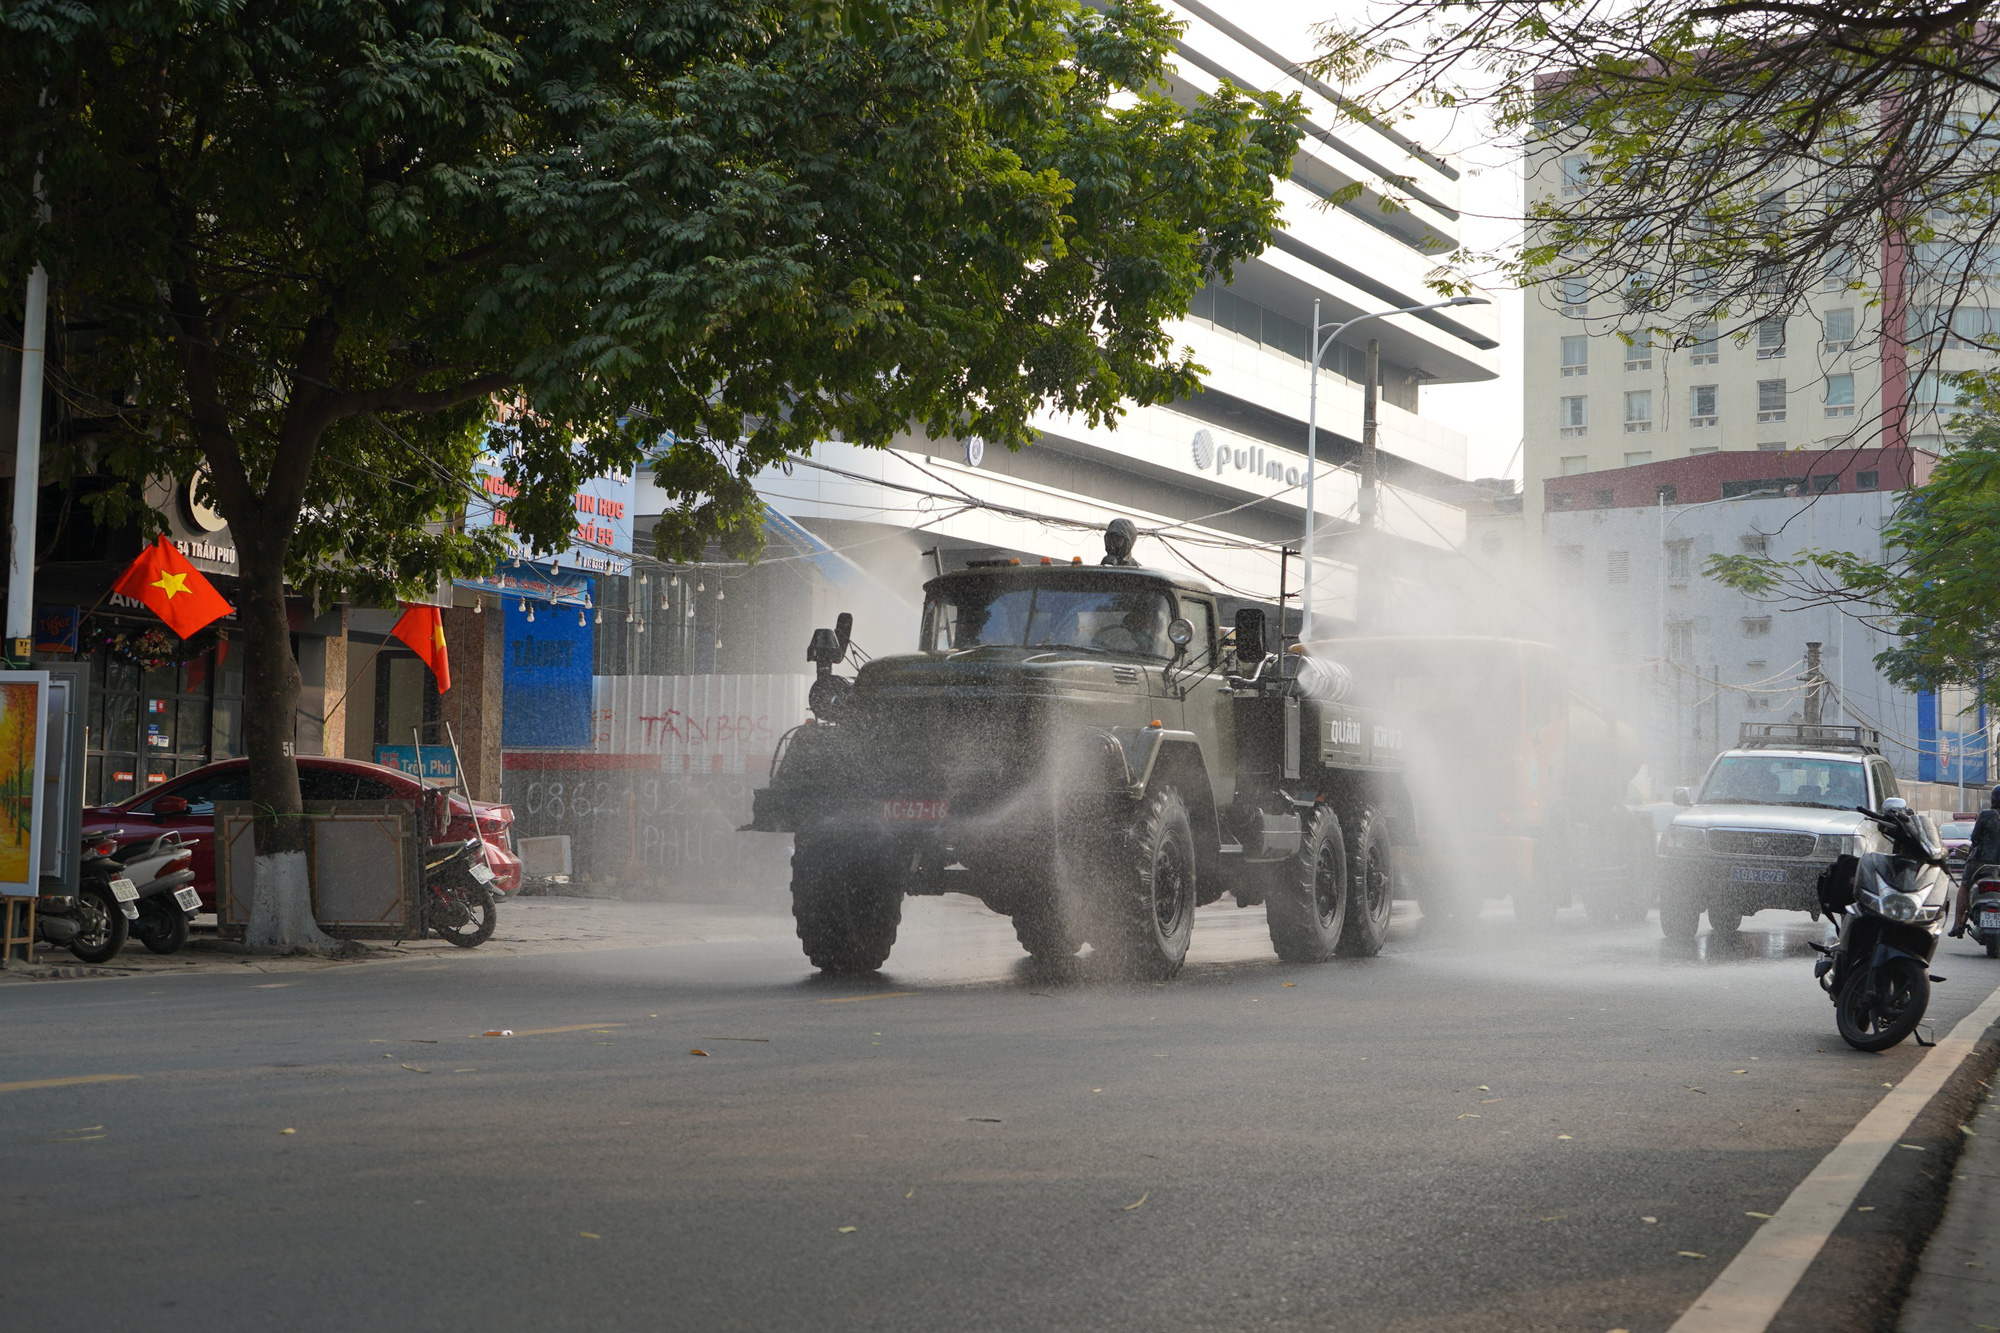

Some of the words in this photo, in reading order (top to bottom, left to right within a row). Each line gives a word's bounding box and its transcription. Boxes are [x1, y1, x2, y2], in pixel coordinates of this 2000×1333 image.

[574, 493, 596, 514] TIN
[598, 497, 625, 522] HỌC
[576, 517, 595, 542] SỐ
[597, 527, 614, 547] 55
[217, 545, 236, 564] PHÚ
[40, 615, 72, 636] Tiger
[1331, 717, 1360, 745] QUÂN
[430, 760, 452, 775] Phú
[883, 802, 947, 819] KC-67-16
